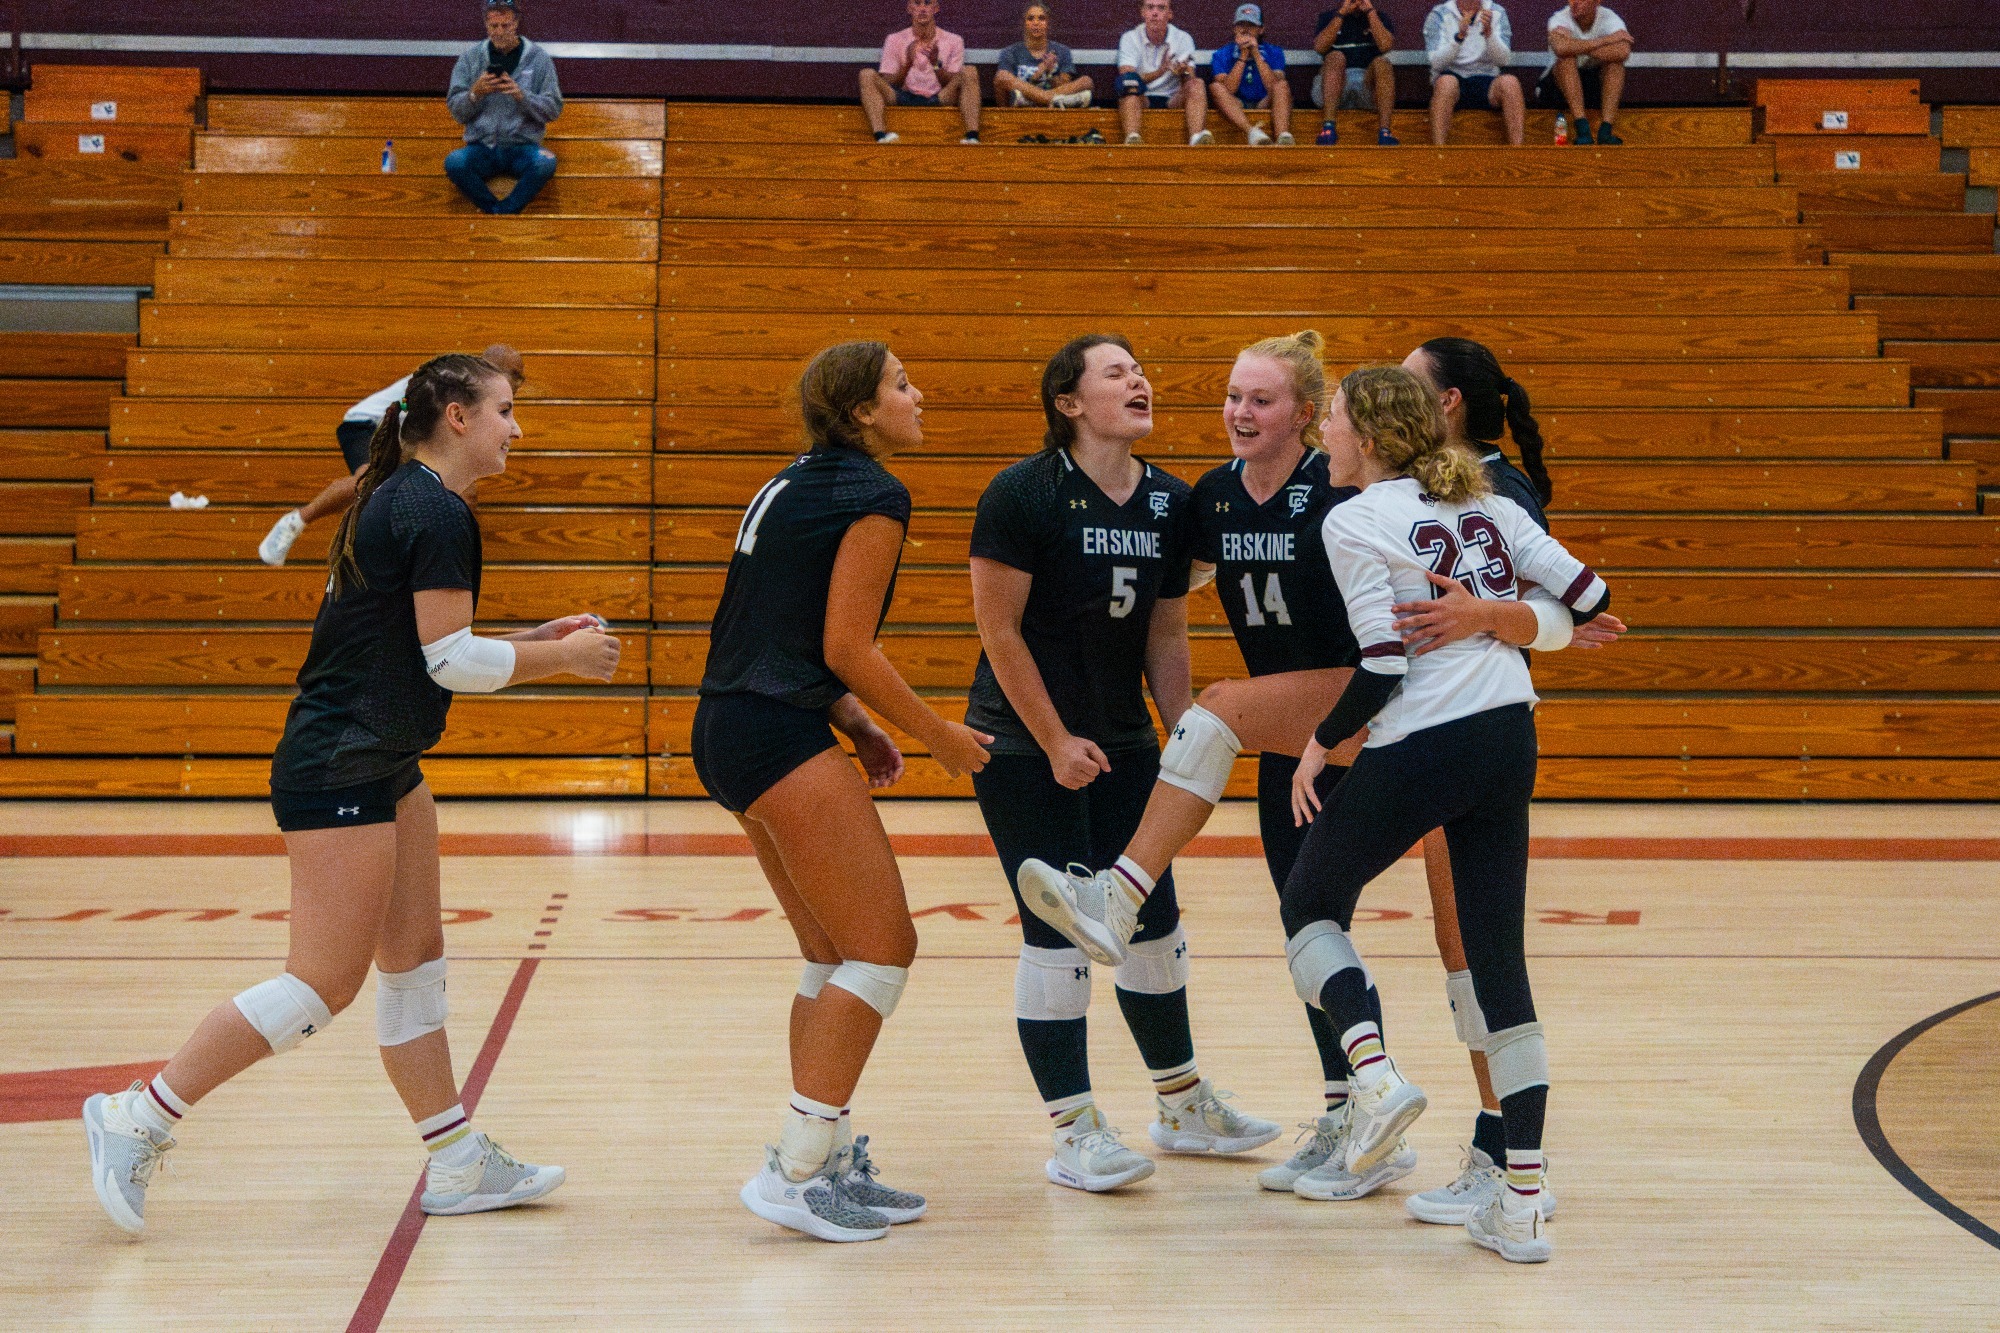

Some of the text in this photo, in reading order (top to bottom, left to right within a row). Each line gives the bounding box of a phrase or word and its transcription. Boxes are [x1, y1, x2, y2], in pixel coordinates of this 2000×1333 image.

[1082, 527, 1162, 558] ERSKINE
[1222, 533, 1296, 561] ERSKINE
[1408, 510, 1516, 601] 23
[1108, 566, 1138, 618] 5
[1239, 572, 1293, 627] 14
